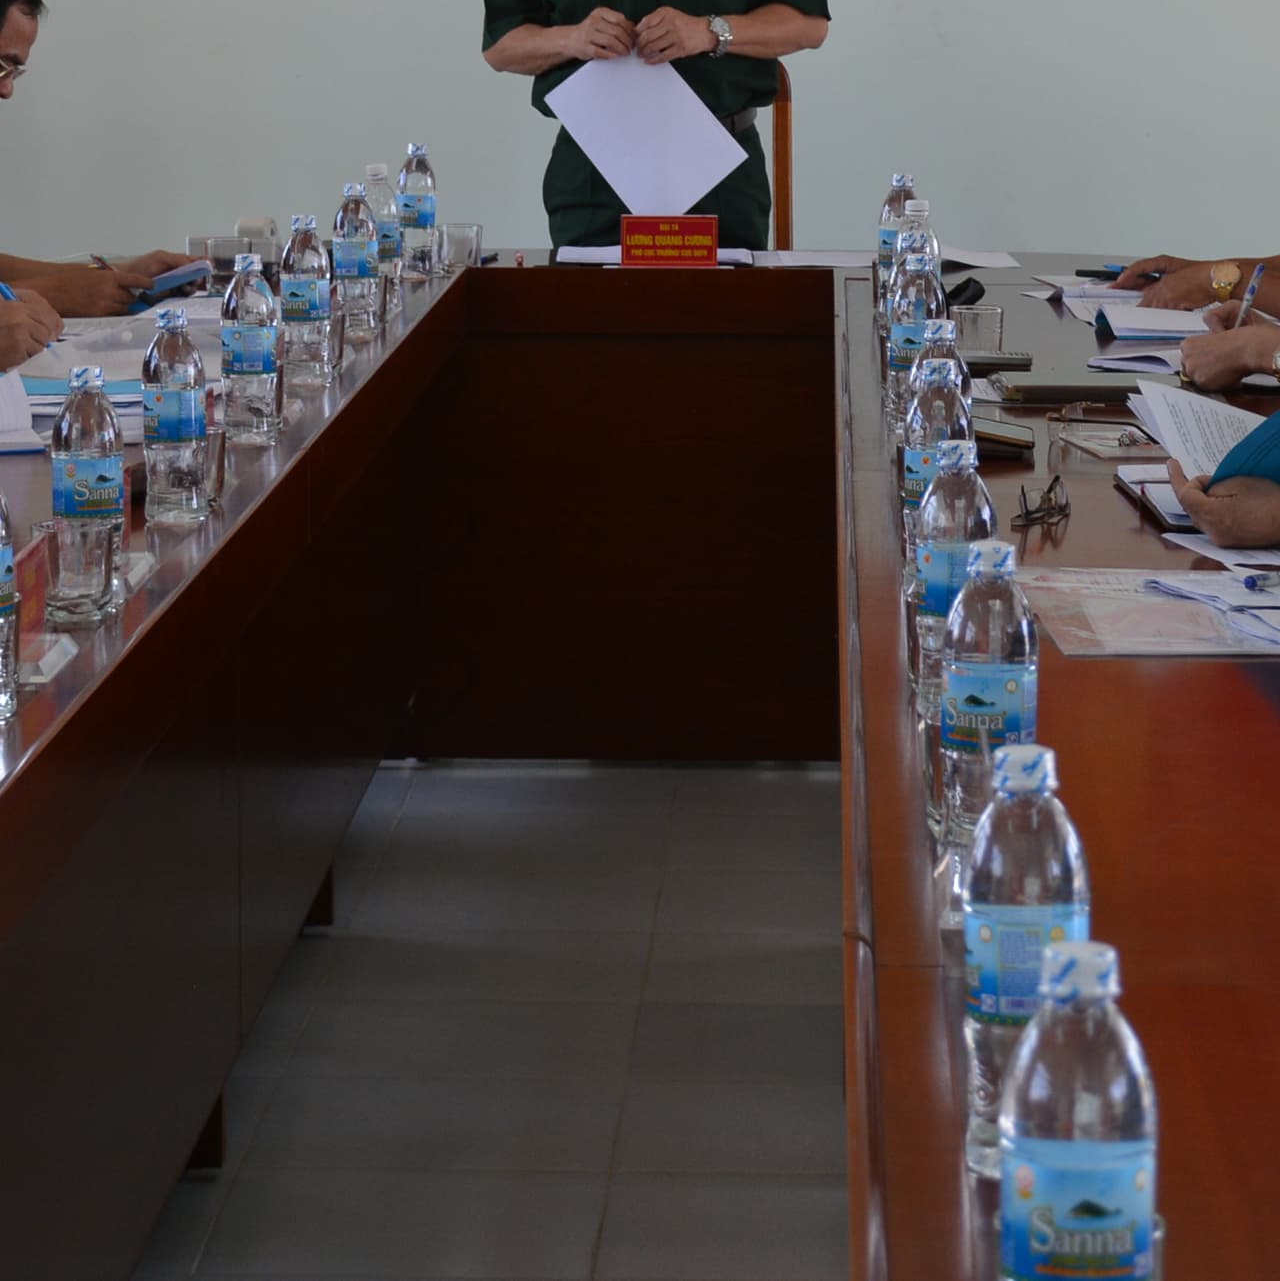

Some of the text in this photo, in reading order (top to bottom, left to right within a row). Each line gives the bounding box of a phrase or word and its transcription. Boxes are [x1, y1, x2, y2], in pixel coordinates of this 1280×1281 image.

[74, 480, 119, 500] Sanna
[947, 698, 1003, 729] Sanna
[1030, 1206, 1133, 1255] Sanna
